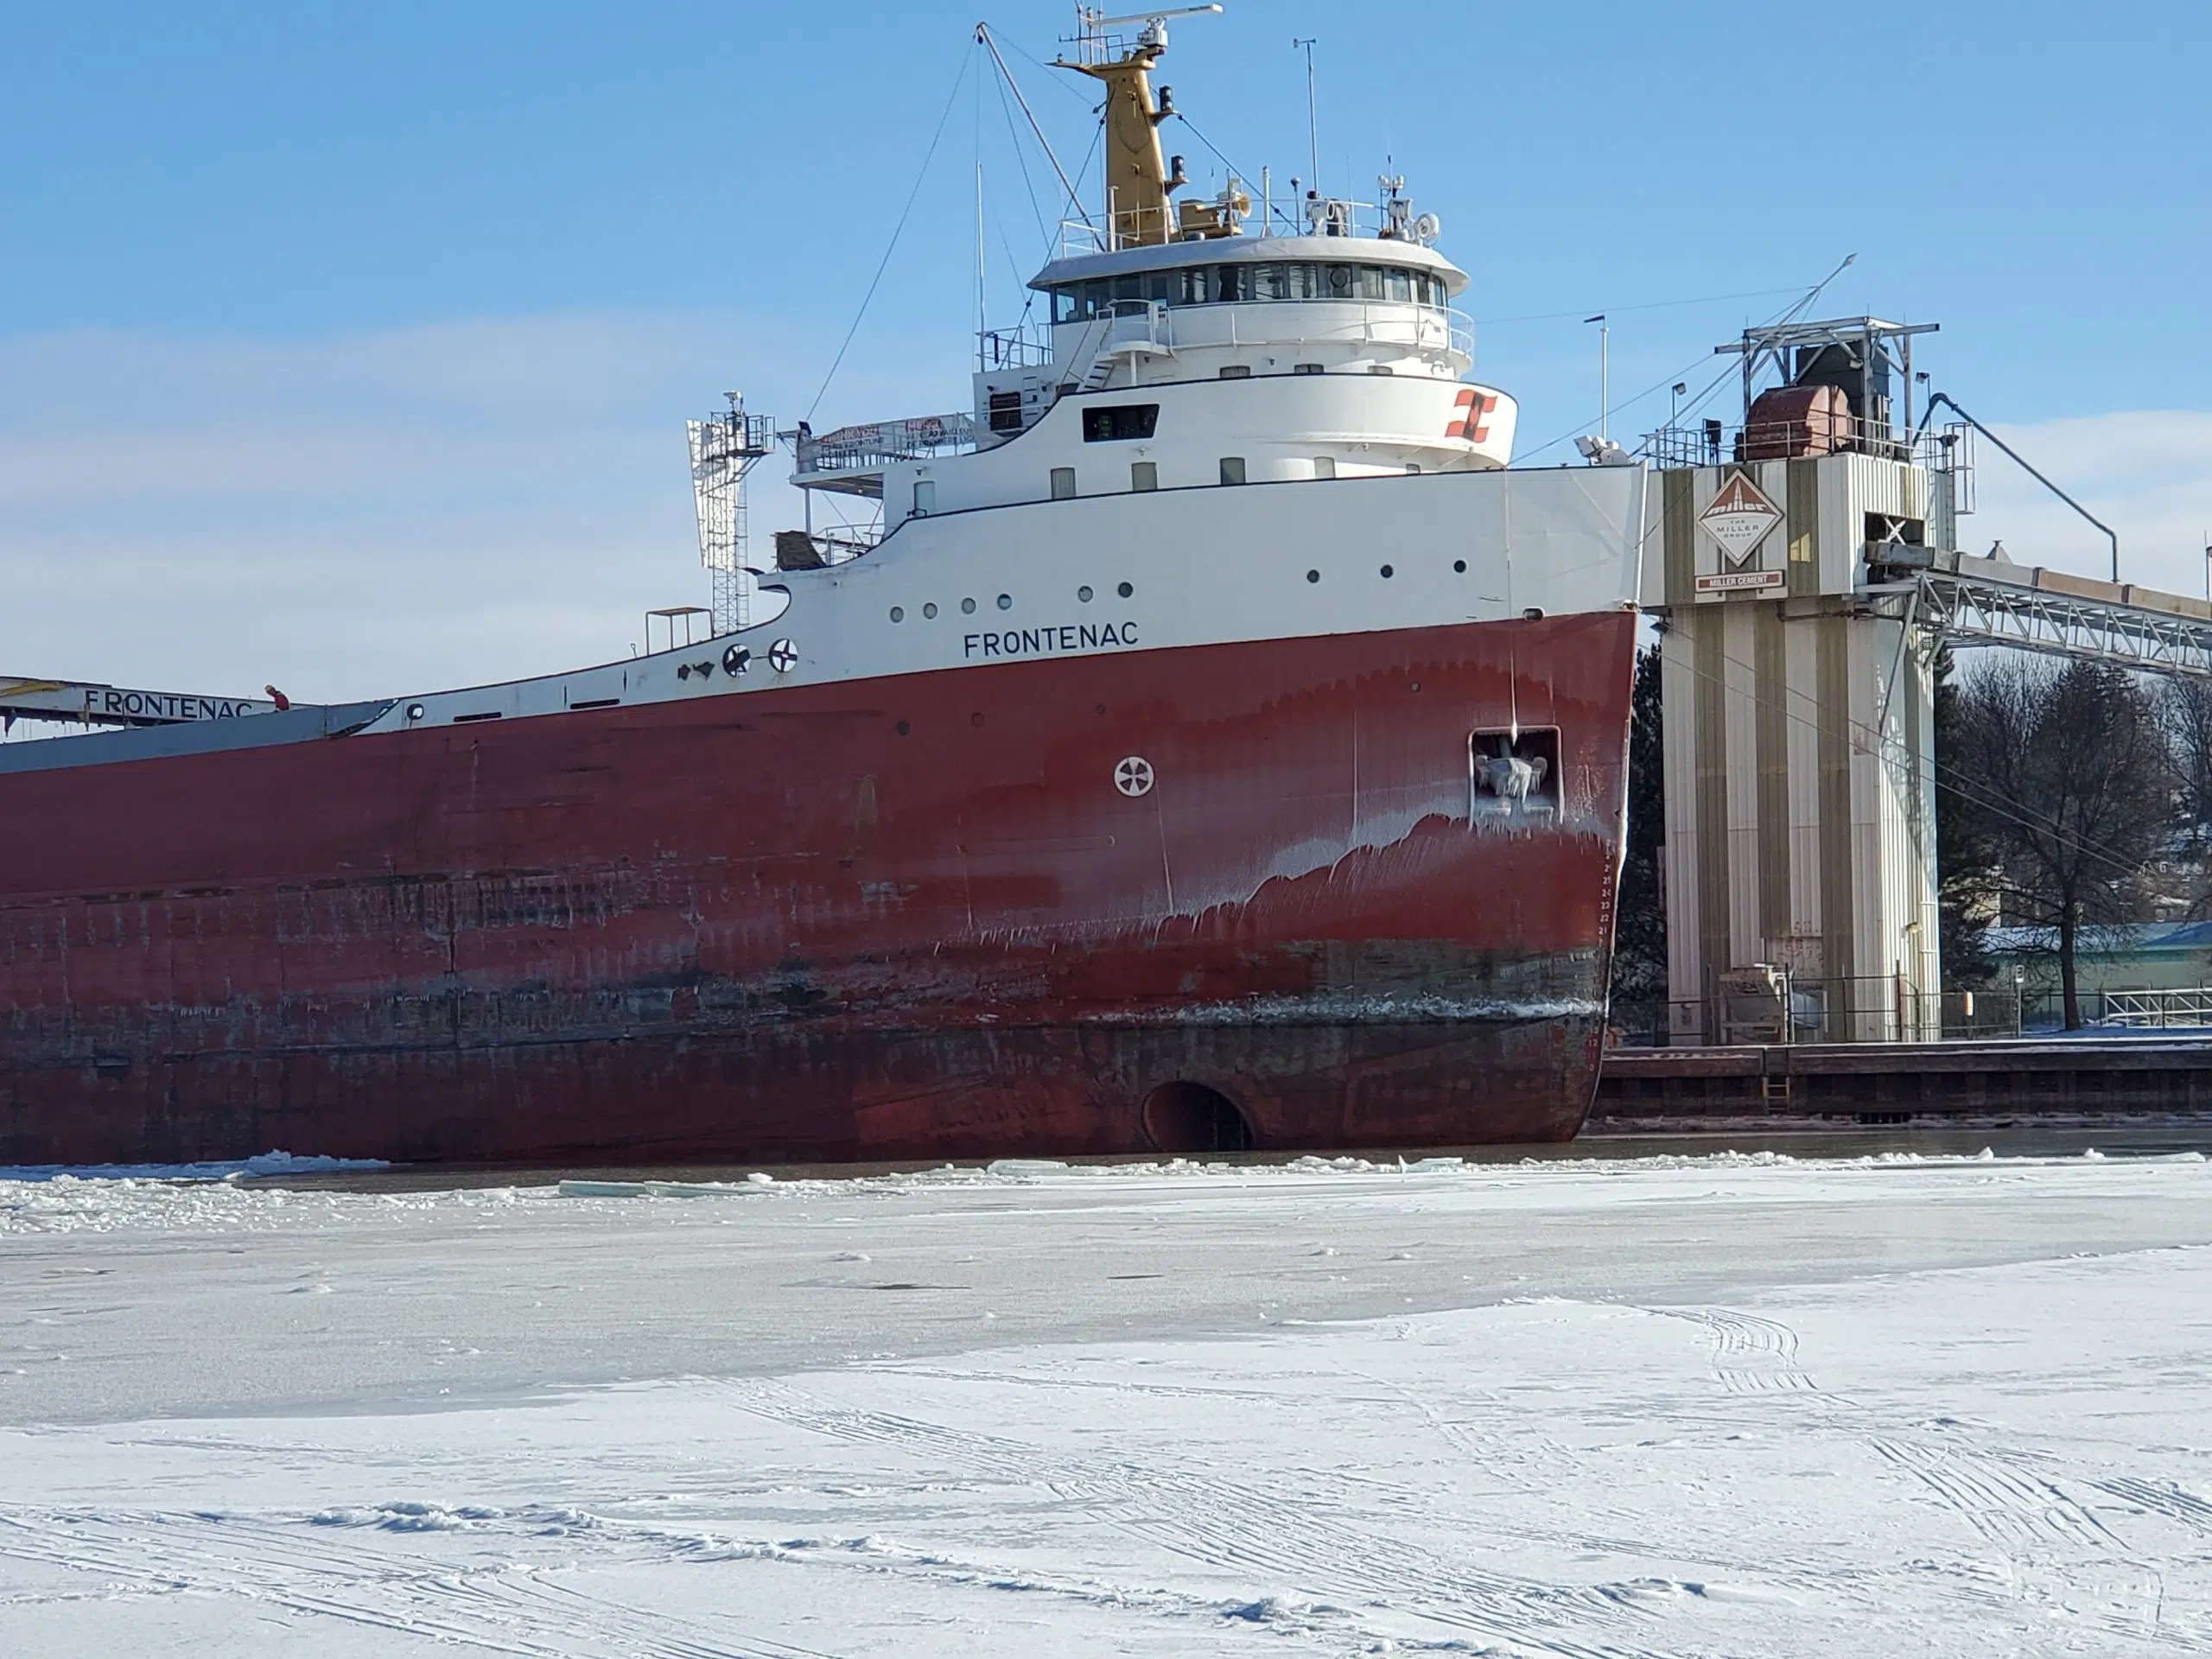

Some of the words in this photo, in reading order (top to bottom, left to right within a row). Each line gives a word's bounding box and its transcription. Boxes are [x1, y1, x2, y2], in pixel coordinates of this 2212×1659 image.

[1716, 524, 1759, 533] MILLER
[1709, 577, 1737, 587] MILLER
[1737, 575, 1768, 585] CEMENT
[963, 621, 1139, 658] FRONTENAC
[86, 690, 252, 721] FRONTENAC
